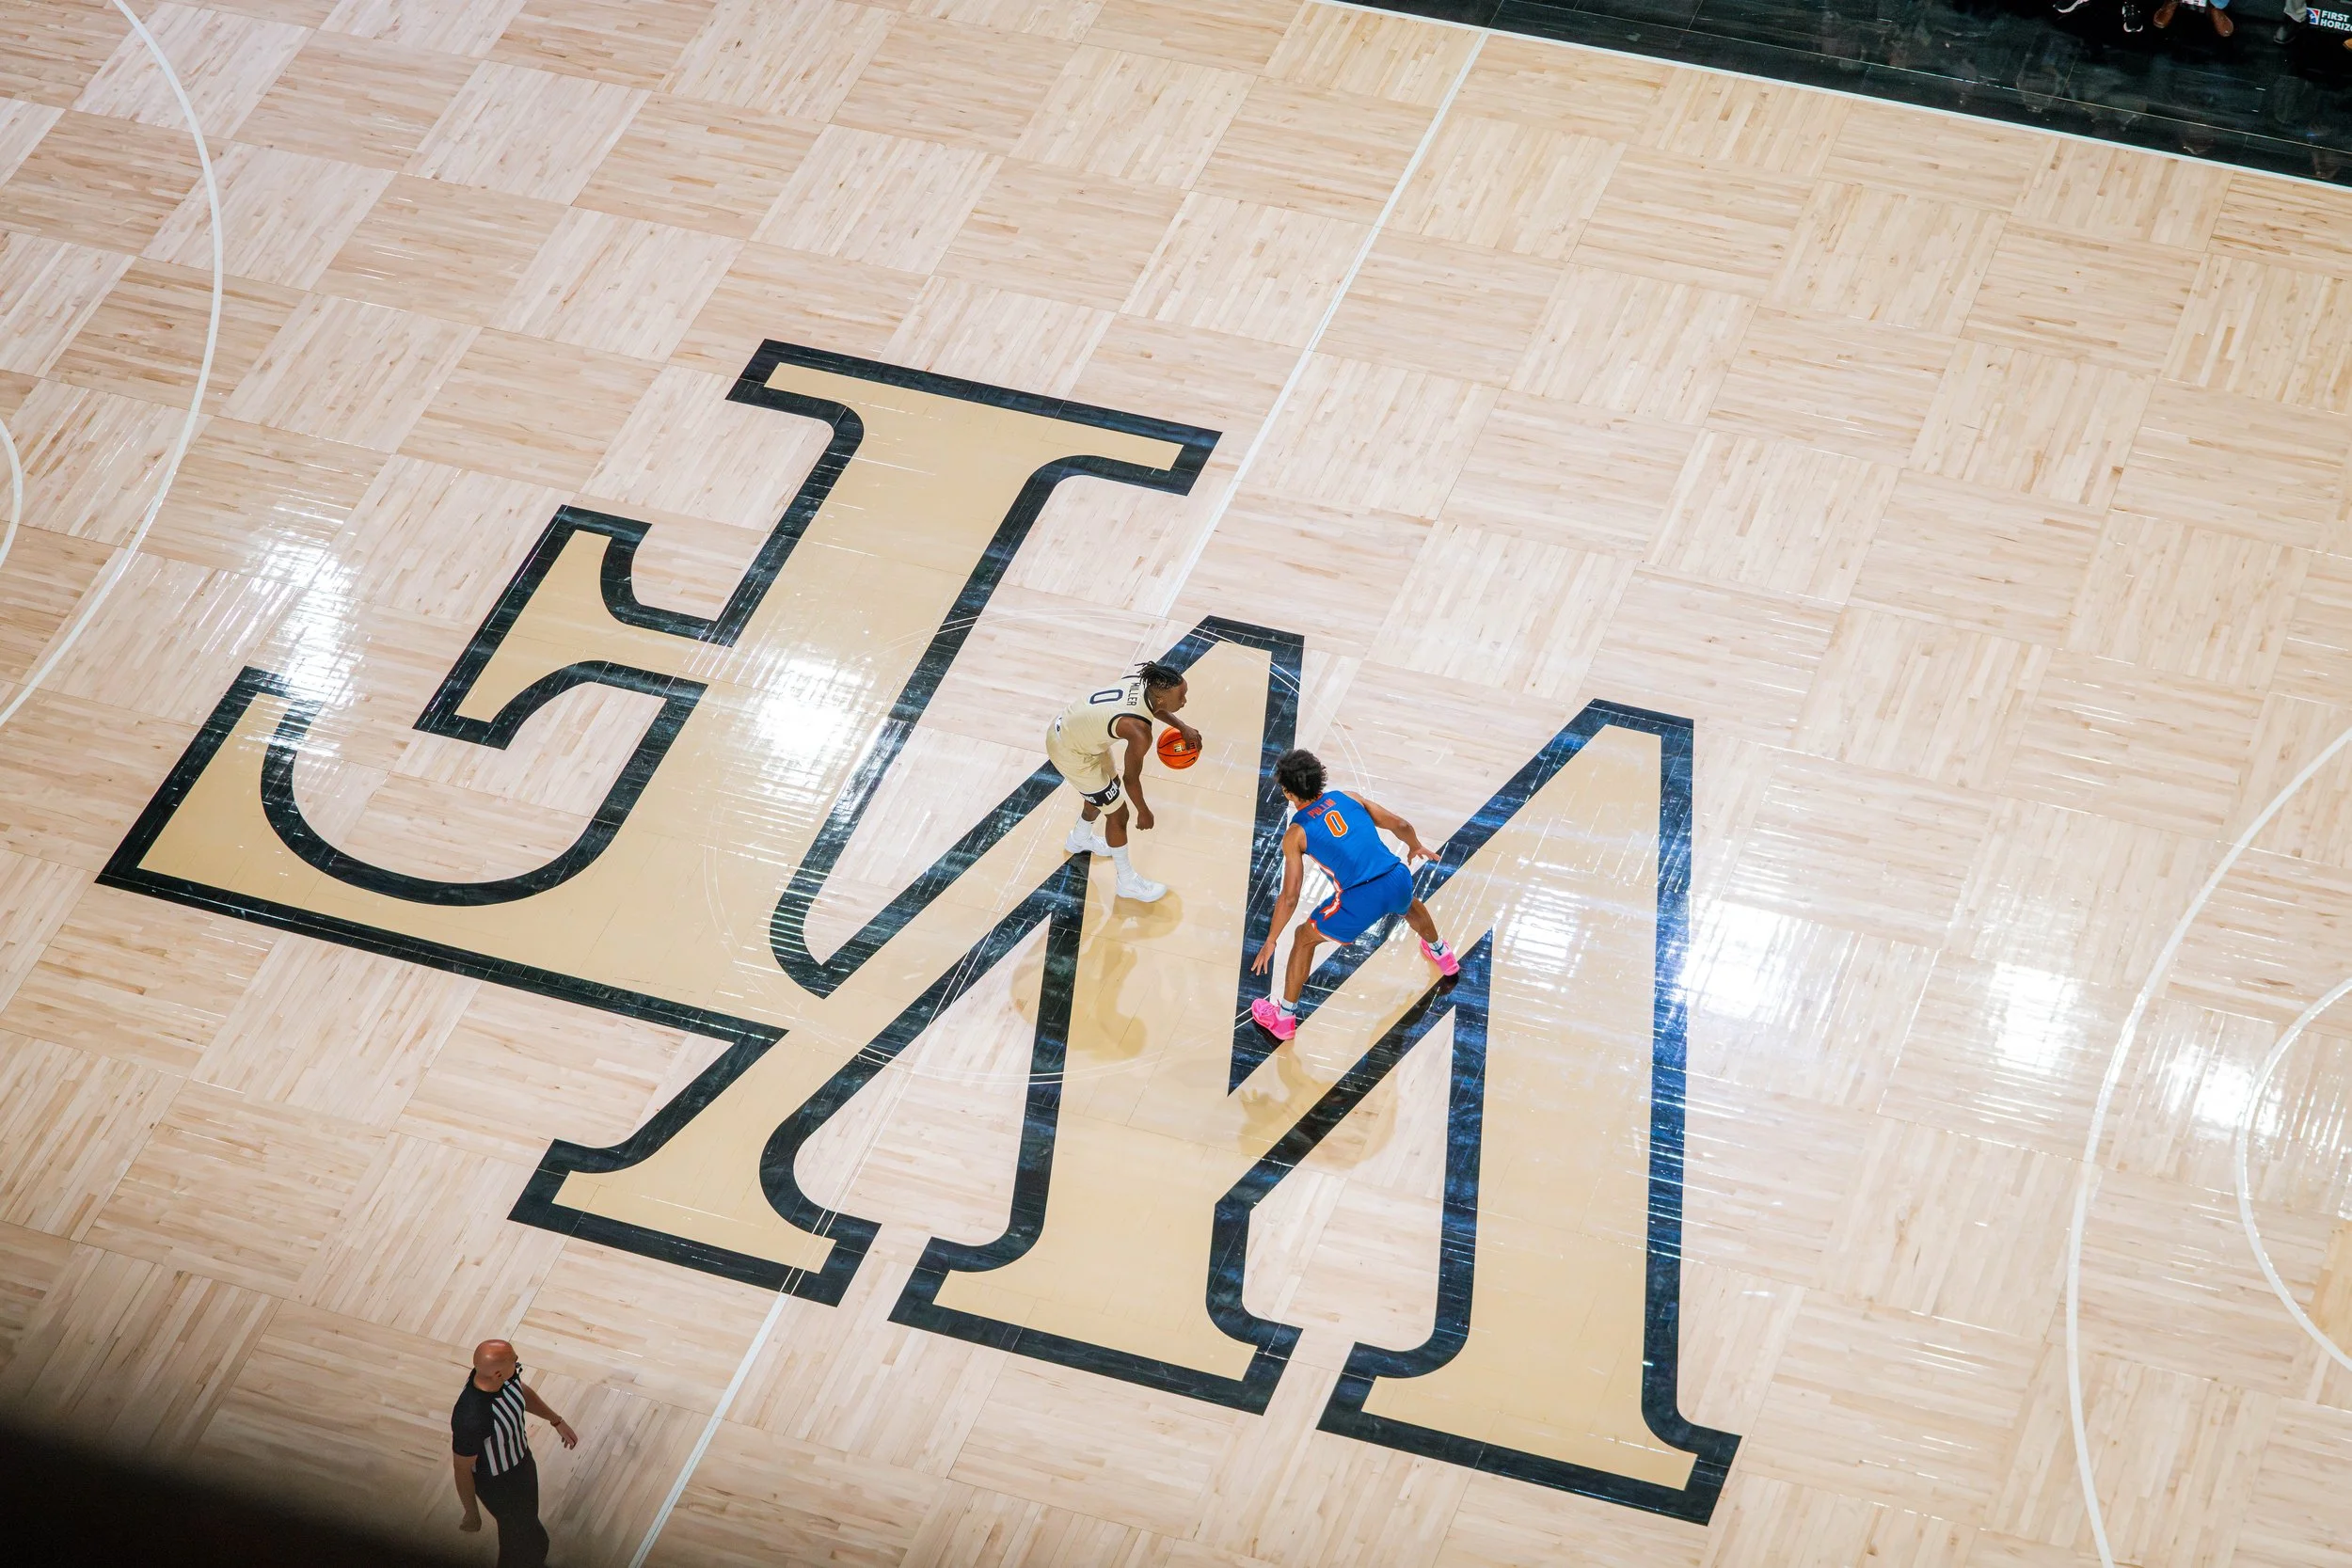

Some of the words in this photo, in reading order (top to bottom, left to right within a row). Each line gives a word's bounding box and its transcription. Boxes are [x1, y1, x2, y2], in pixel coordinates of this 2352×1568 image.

[2321, 9, 2350, 23] FIRST
[2320, 18, 2352, 33] HORIZ
[1089, 689, 1123, 705] 0
[1126, 681, 1141, 706] MILLER
[1324, 810, 1349, 838] 0
